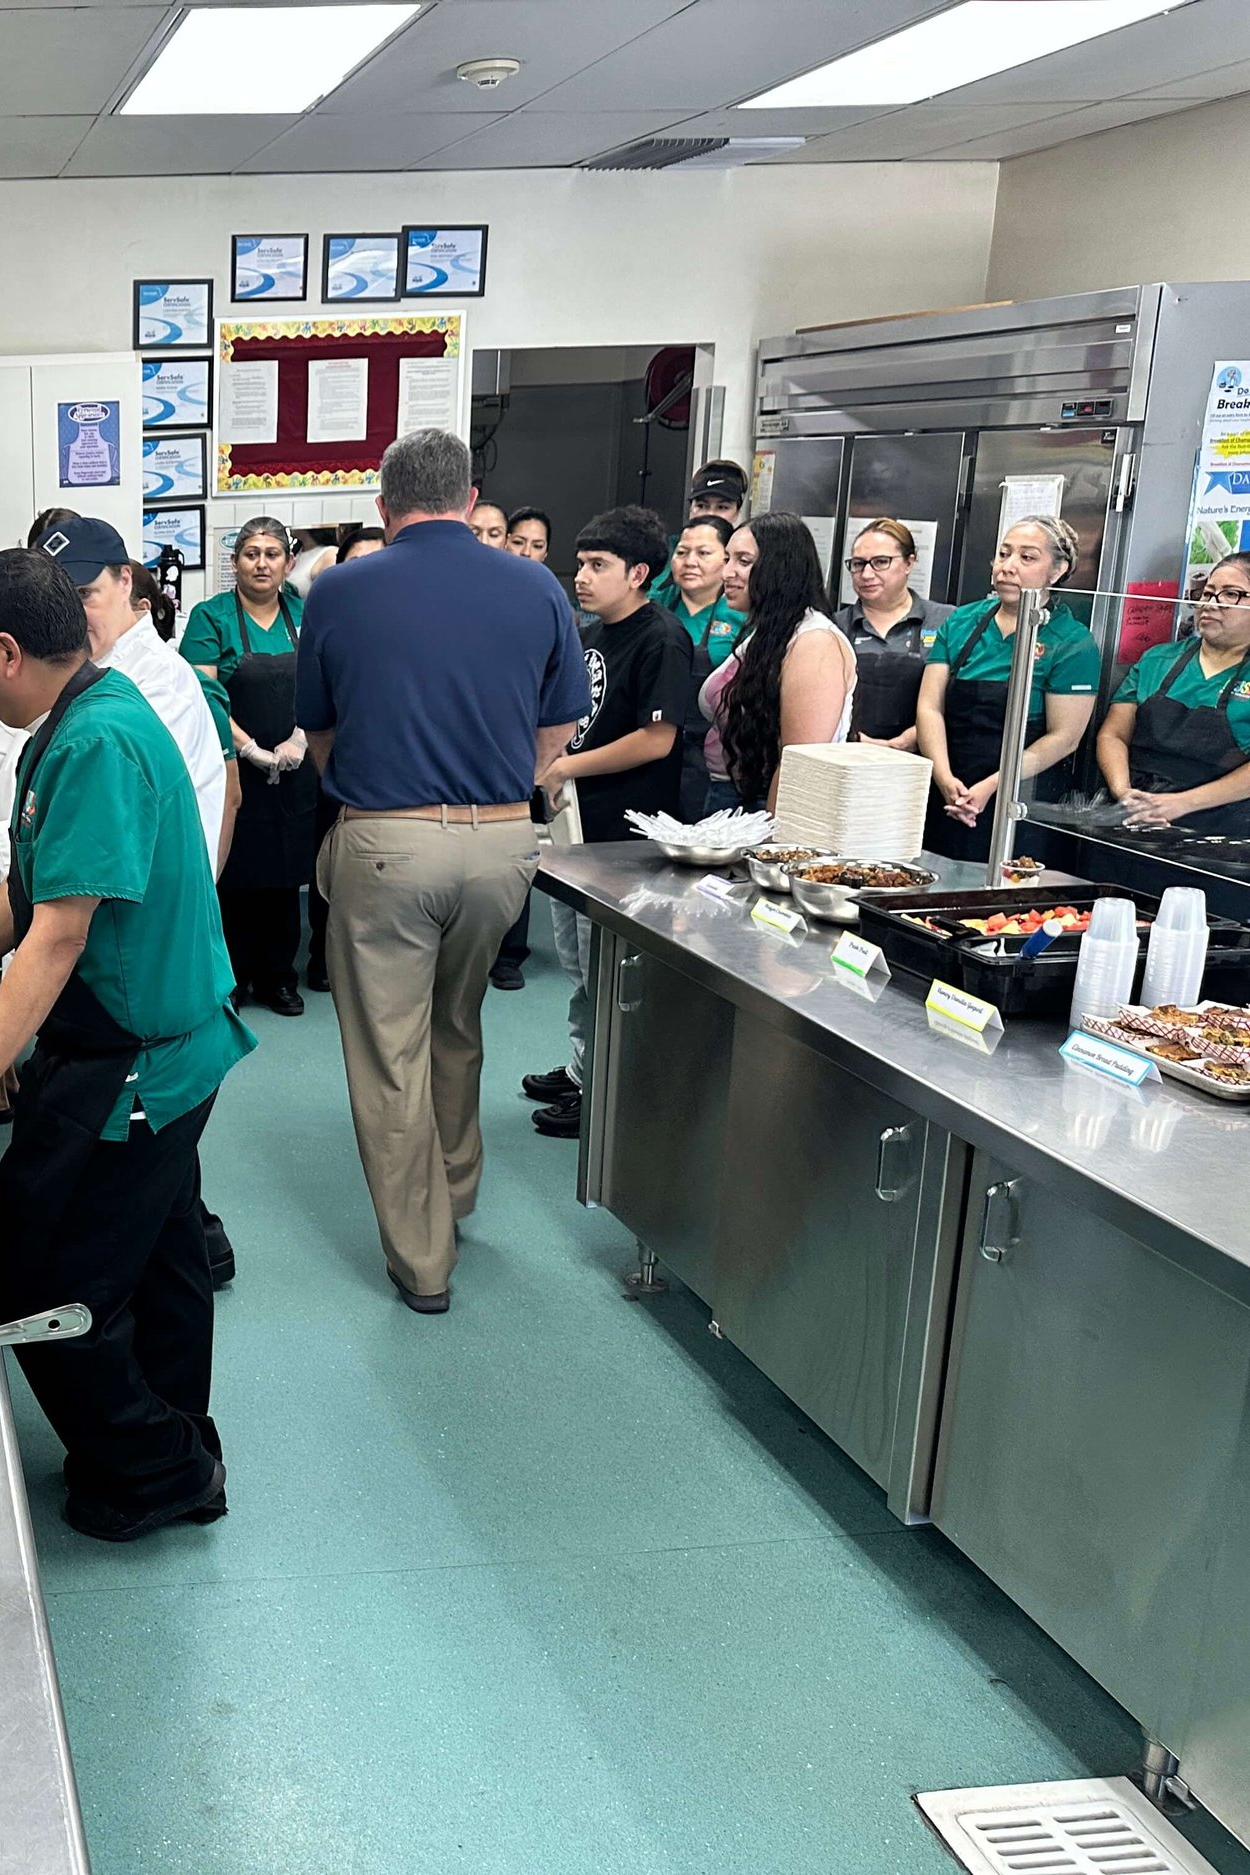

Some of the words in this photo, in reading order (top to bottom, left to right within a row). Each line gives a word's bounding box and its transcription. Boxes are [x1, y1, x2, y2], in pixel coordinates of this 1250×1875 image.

[1197, 504, 1229, 514] Nature's
[1071, 1043, 1096, 1058] Cinnamon
[1095, 1054, 1112, 1066] Bread
[1112, 1059, 1135, 1076] Pudding
